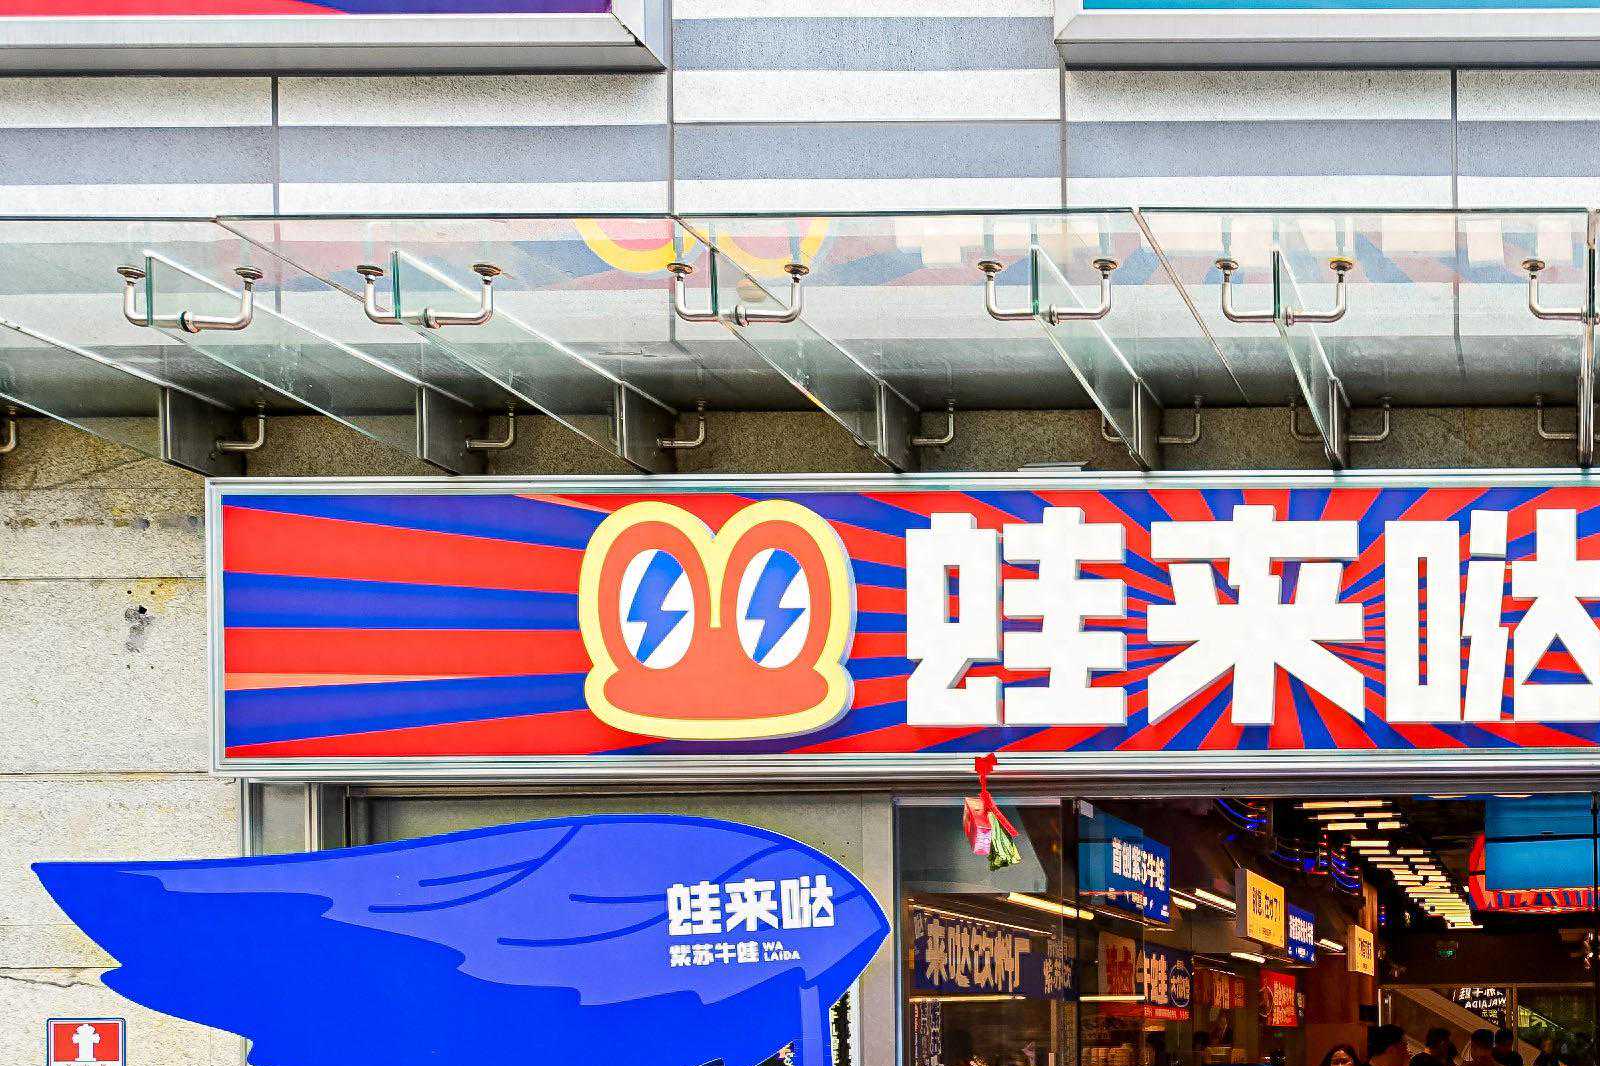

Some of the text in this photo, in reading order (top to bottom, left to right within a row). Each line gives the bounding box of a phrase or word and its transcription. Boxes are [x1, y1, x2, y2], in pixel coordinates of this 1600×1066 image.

[667, 875, 835, 936] 蛙来哒
[669, 941, 760, 967] 紫苏牛蛙
[762, 941, 784, 951] WA
[763, 950, 801, 962] LAIDA
